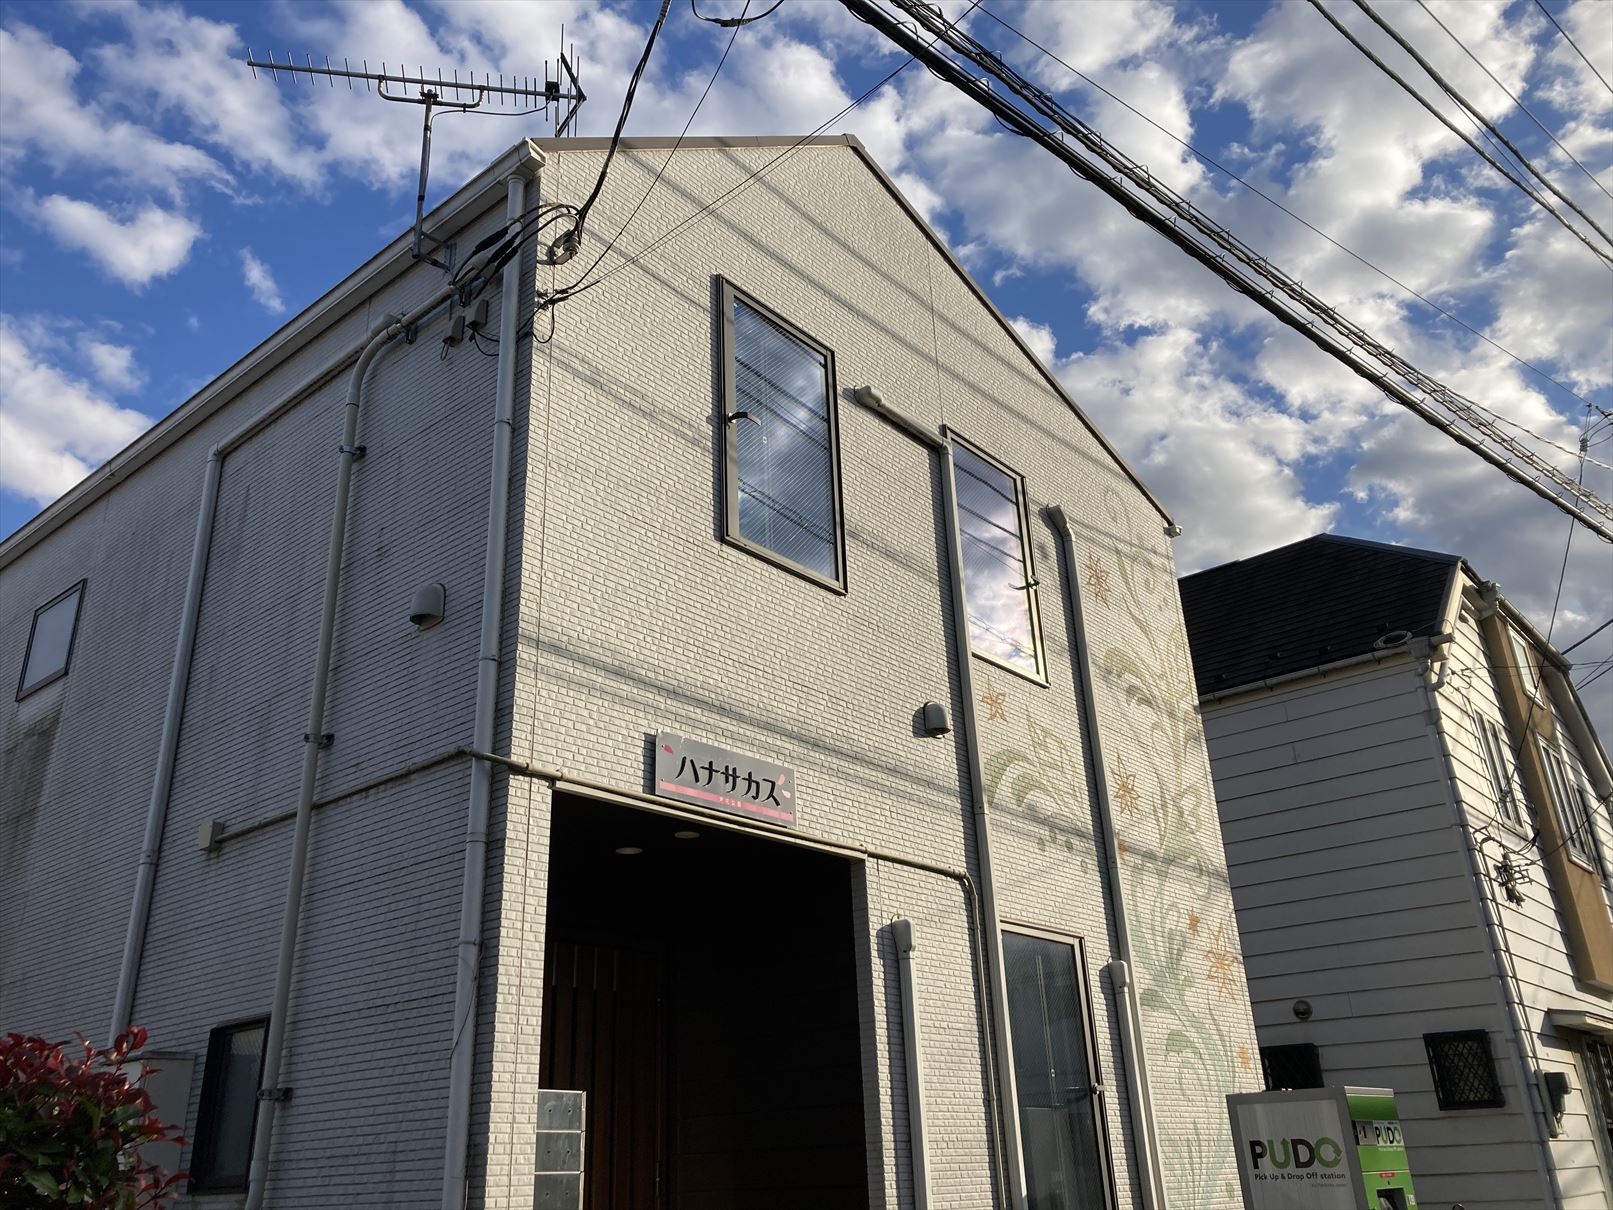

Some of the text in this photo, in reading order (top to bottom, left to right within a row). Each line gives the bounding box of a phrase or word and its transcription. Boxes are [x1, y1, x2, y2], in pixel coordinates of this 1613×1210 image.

[674, 755, 781, 807] ハナサカス
[1374, 1126, 1402, 1145] PUDO
[1249, 1136, 1343, 1169] PUDO
[1254, 1173, 1267, 1181] Pick
[1269, 1173, 1279, 1181] Up
[1287, 1172, 1305, 1181] Drop
[1306, 1172, 1318, 1180] Off
[1320, 1171, 1346, 1180] station
